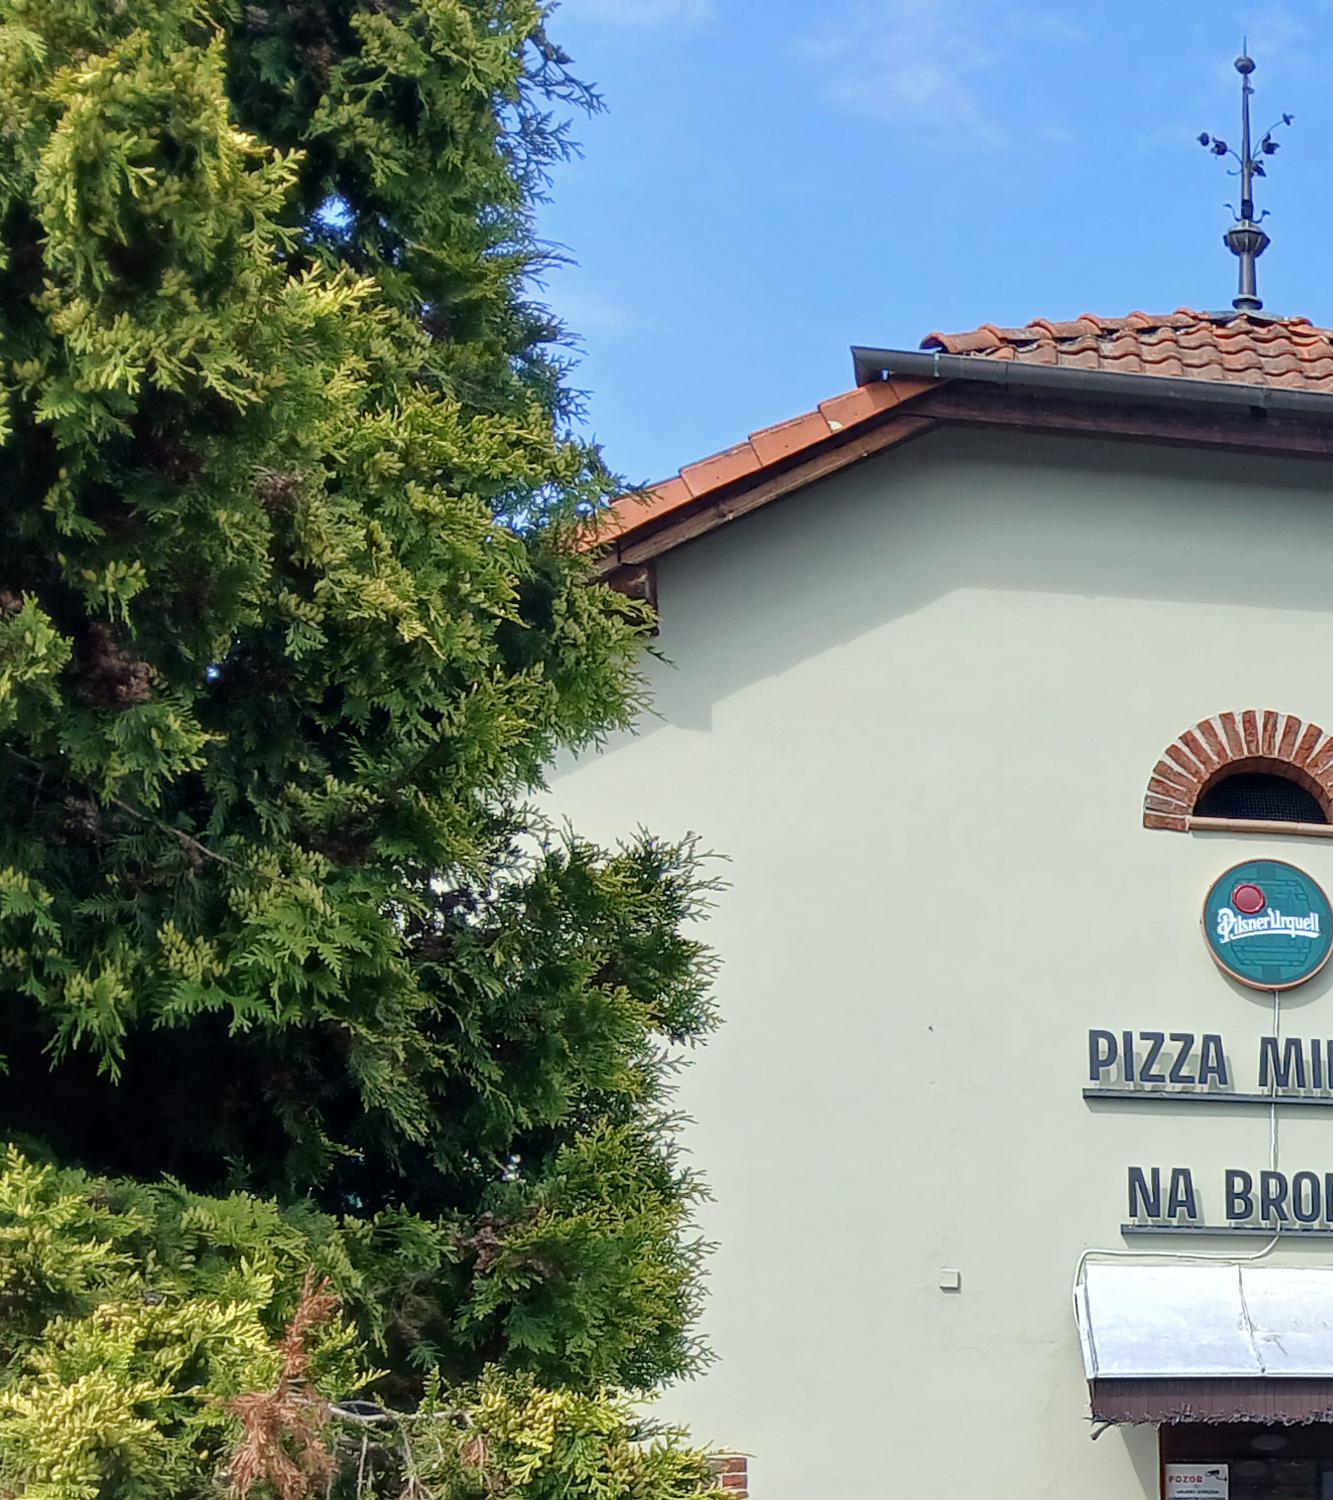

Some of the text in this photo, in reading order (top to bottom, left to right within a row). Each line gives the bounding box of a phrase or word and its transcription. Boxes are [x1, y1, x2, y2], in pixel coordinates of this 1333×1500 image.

[1217, 907, 1319, 943] Pilsner Urquell
[1089, 1030, 1228, 1085] PIZZA
[1128, 1167, 1197, 1218] NA
